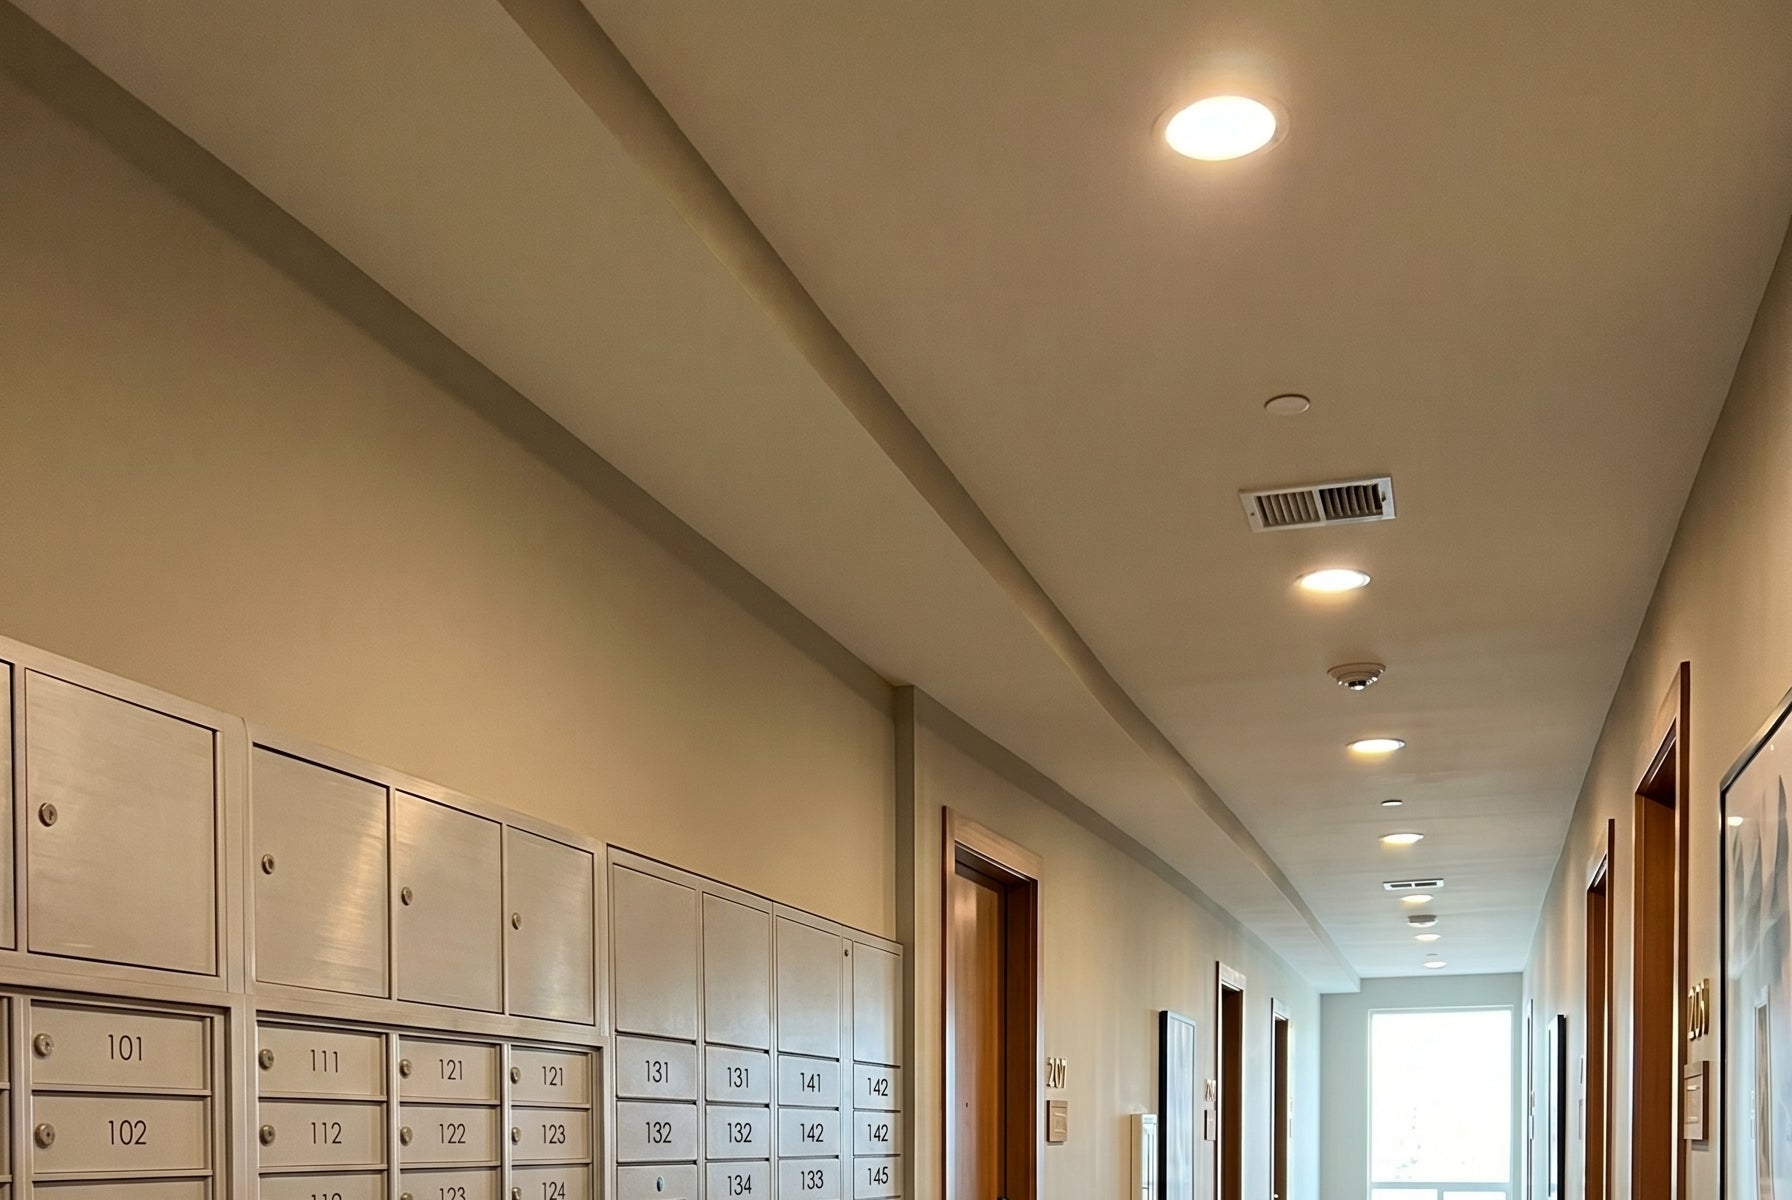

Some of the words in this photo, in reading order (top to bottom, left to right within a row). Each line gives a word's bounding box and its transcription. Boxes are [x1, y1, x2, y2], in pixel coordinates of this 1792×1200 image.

[108, 1034, 142, 1061] 101
[310, 1049, 338, 1073] 111
[439, 1058, 463, 1081] 121
[645, 1060, 669, 1083] 131
[542, 1065, 563, 1087] 121
[727, 1066, 749, 1089] 131
[800, 1072, 821, 1093] 141
[867, 1077, 889, 1097] 142
[108, 1119, 147, 1146] 102
[311, 1121, 342, 1144] 112
[439, 1123, 466, 1144] 122
[542, 1124, 566, 1145] 123
[645, 1121, 672, 1144] 132
[727, 1122, 752, 1143] 132
[800, 1123, 824, 1143] 142
[867, 1123, 889, 1142] 142
[727, 1174, 752, 1196] 134
[800, 1169, 824, 1190] 133
[867, 1166, 889, 1186] 145
[542, 1181, 566, 1200] 124
